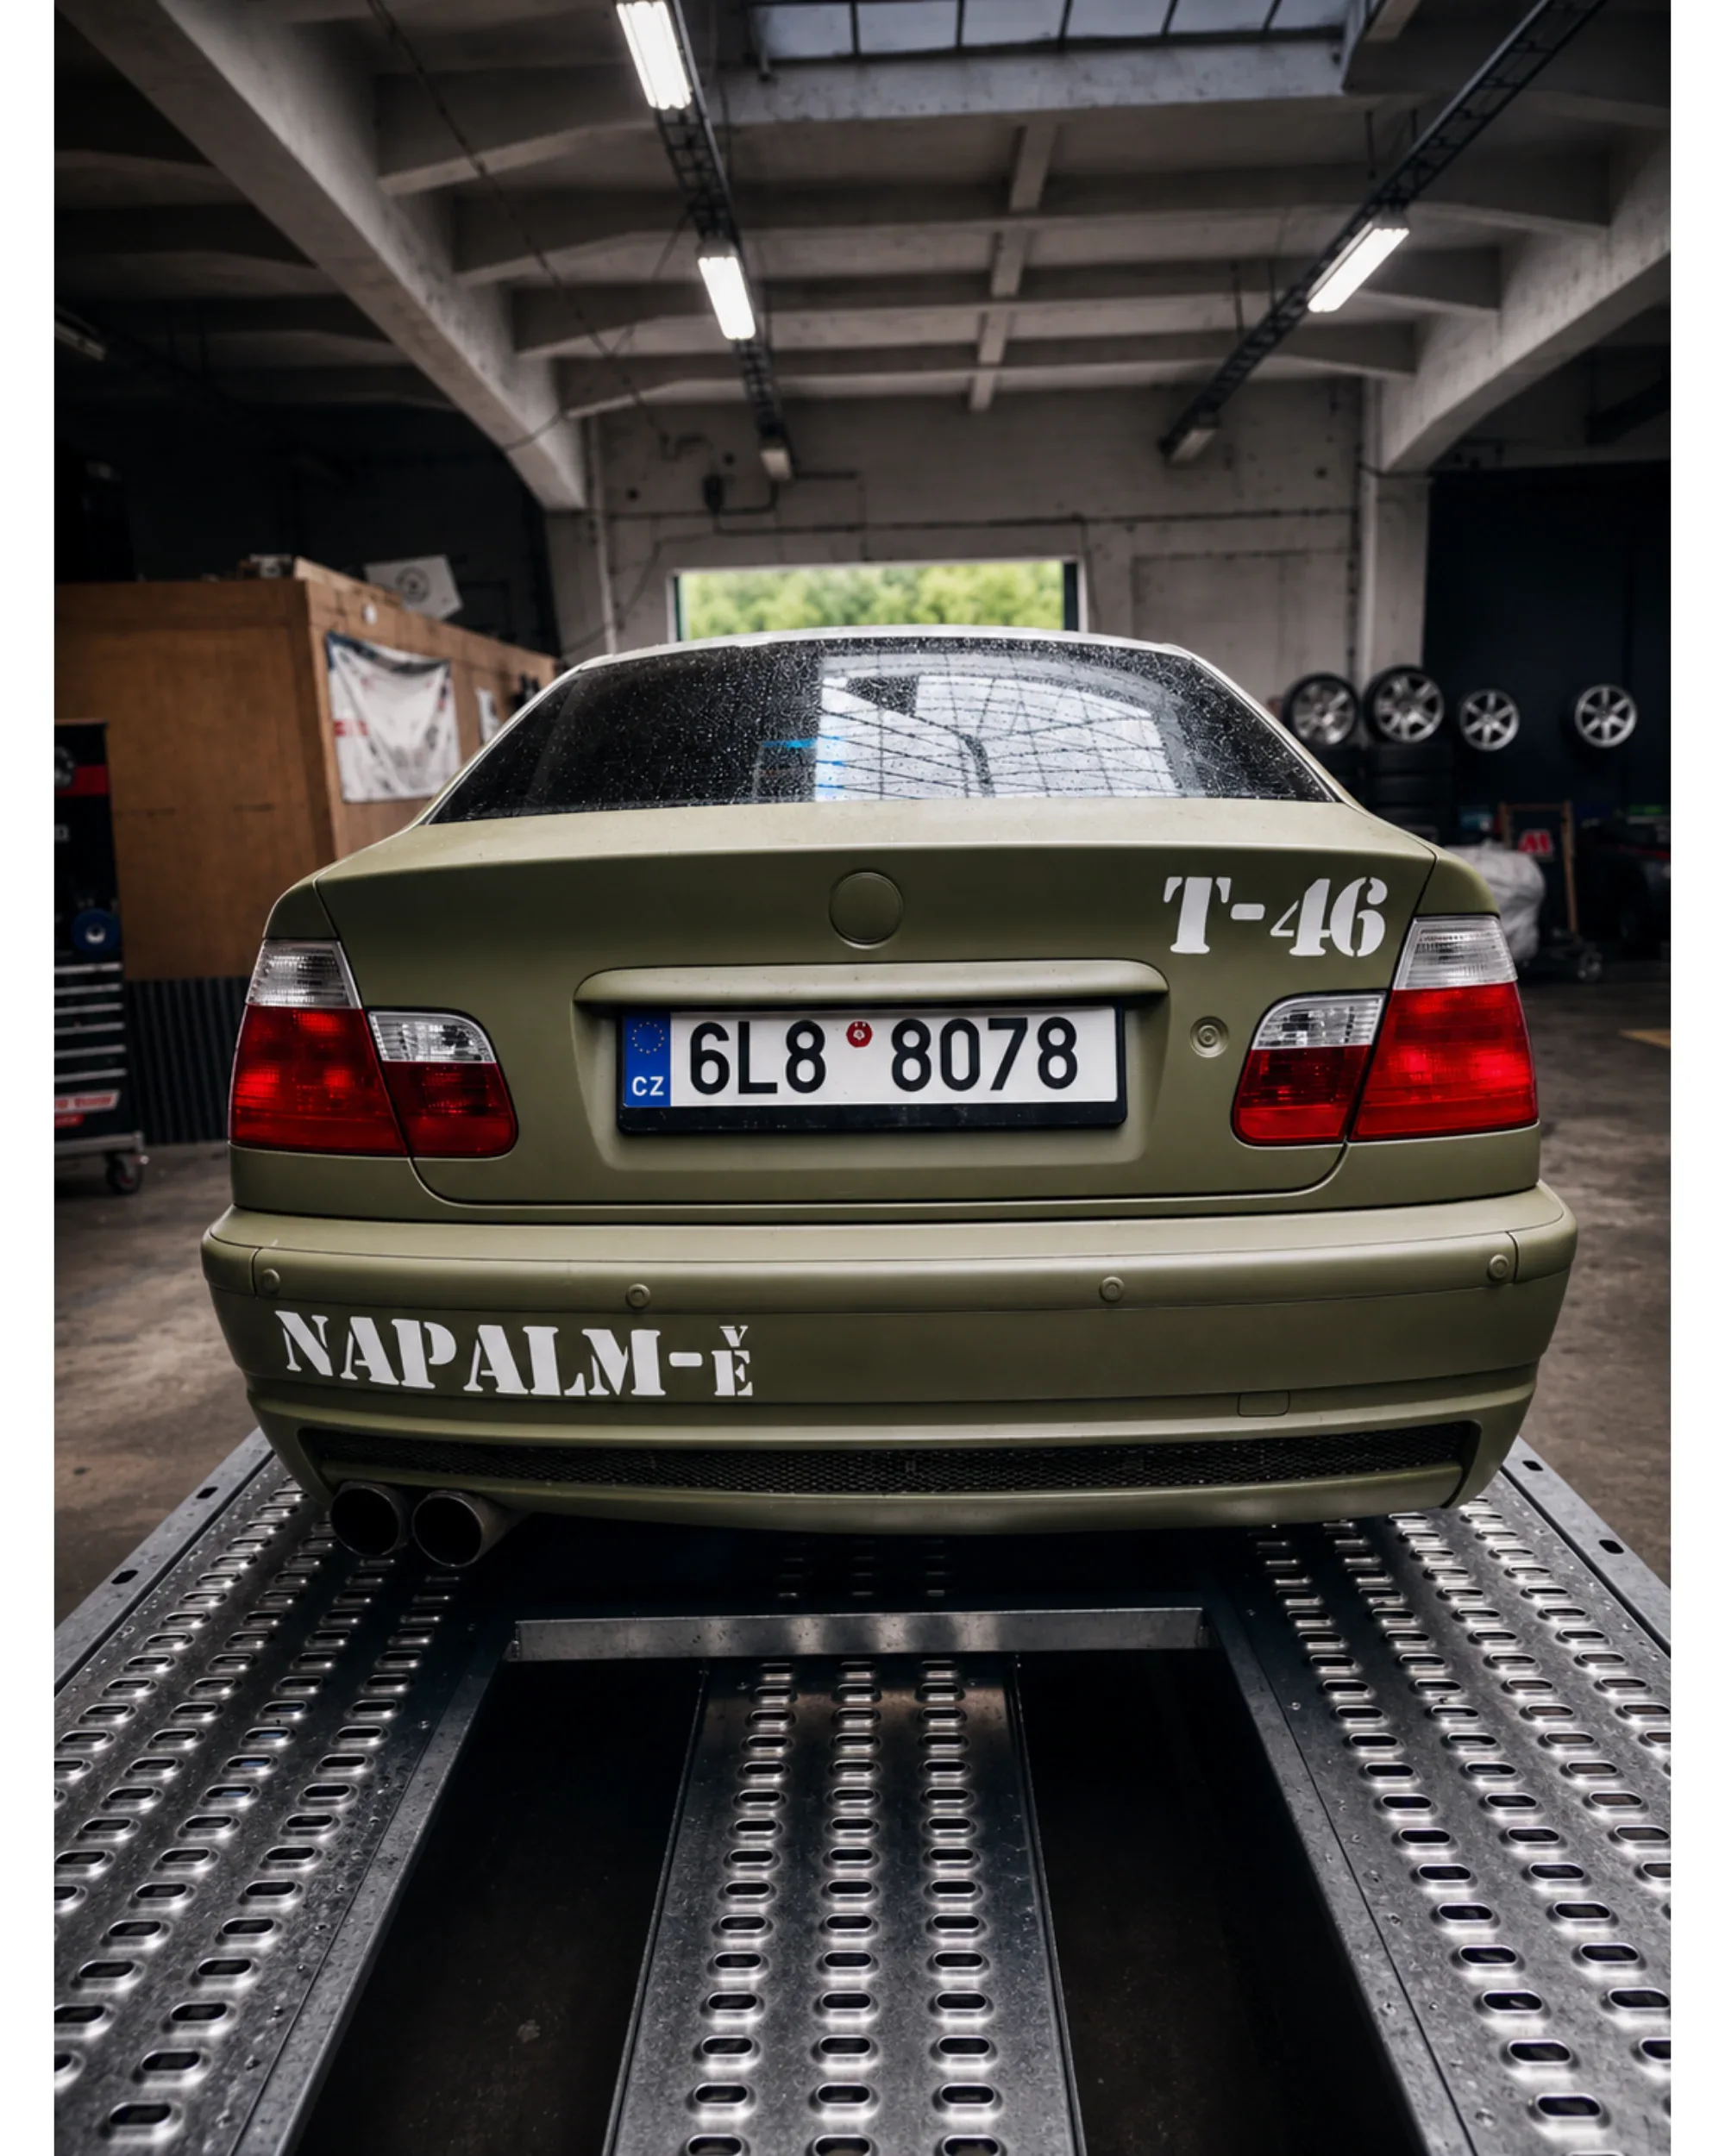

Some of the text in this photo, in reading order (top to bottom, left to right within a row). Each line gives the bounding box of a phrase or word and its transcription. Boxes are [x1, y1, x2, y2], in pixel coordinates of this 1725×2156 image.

[1163, 876, 1388, 957] T-46
[632, 1076, 664, 1096] CZ
[690, 1016, 1077, 1095] 6L8 8078
[274, 1310, 753, 1396] NAPALM-Ě
